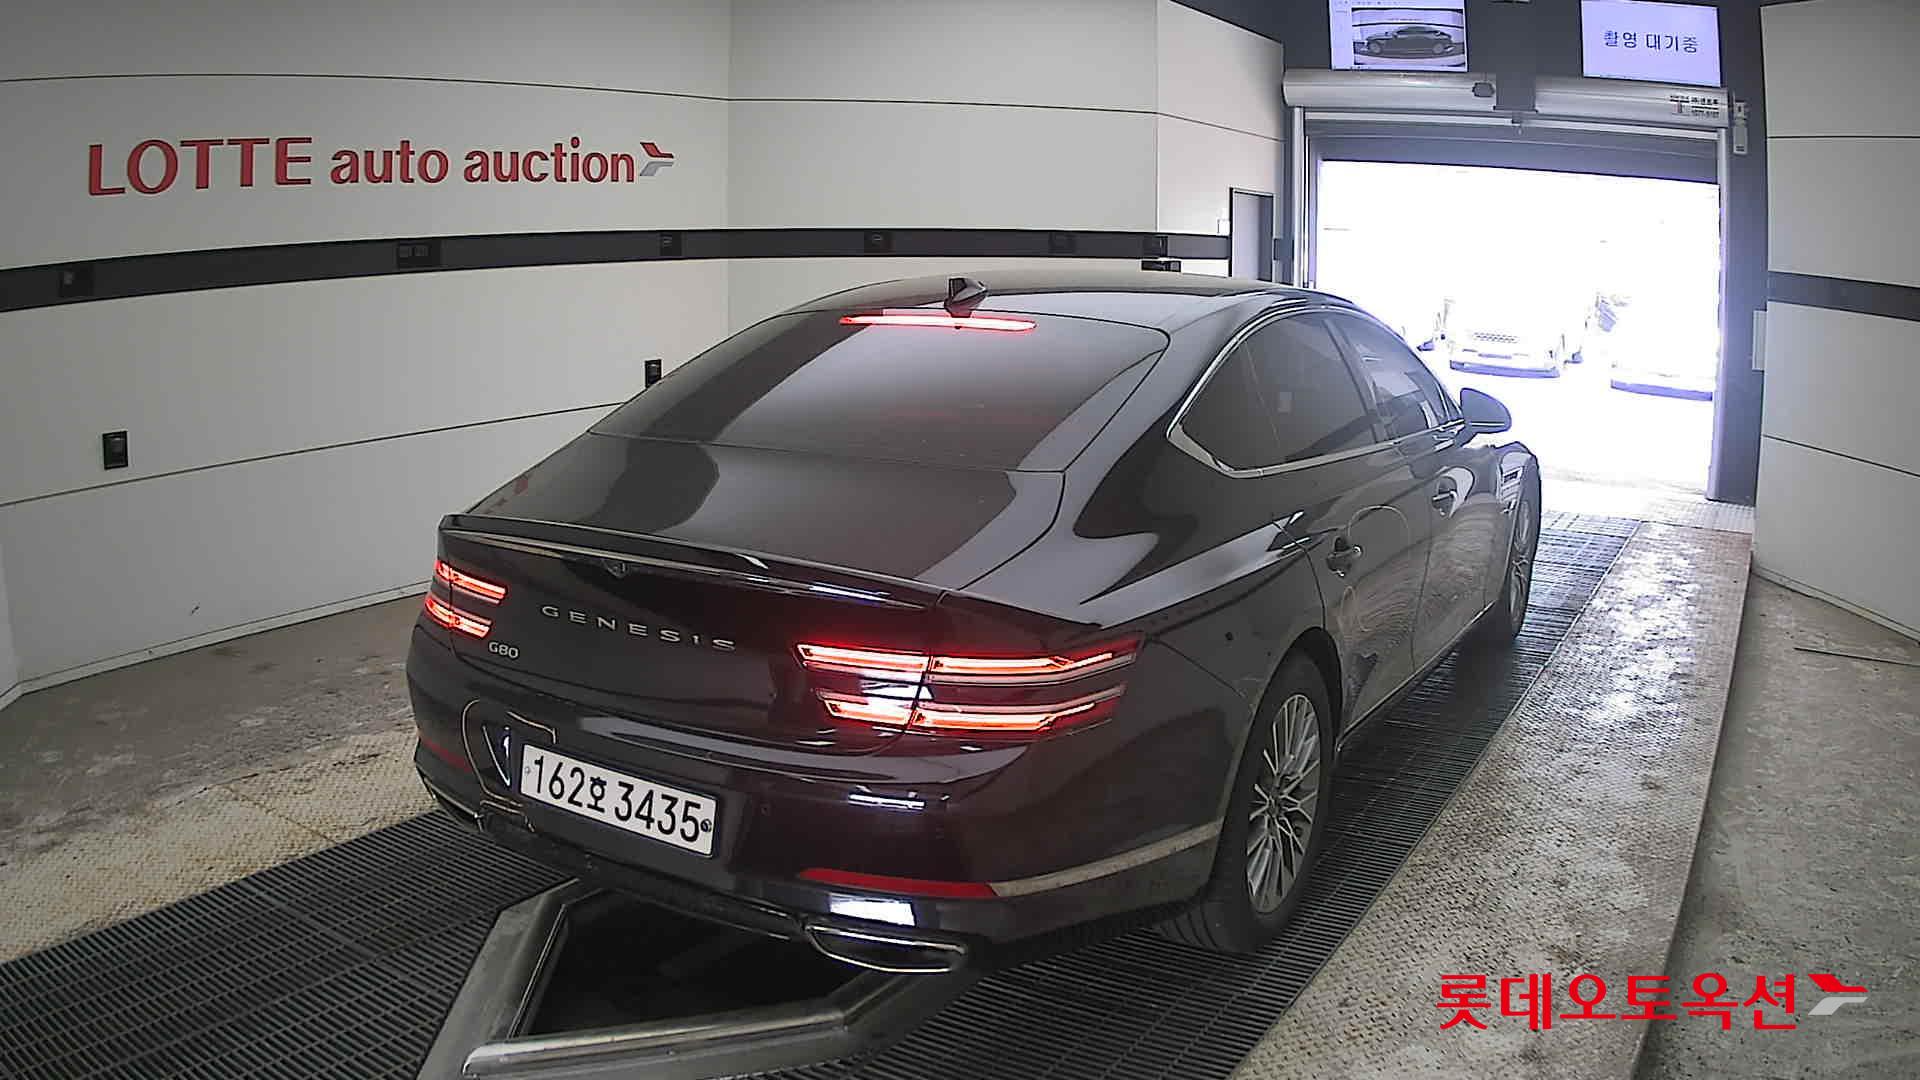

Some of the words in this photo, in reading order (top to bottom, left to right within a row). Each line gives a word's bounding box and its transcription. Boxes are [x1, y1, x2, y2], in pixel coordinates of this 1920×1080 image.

[1646, 33, 1698, 53] 대기중
[88, 137, 313, 196] LOTTE
[330, 140, 449, 184] auto
[463, 137, 635, 183] auction
[488, 641, 519, 659] G80
[541, 605, 736, 651] GENESIS
[613, 781, 701, 843] 3435
